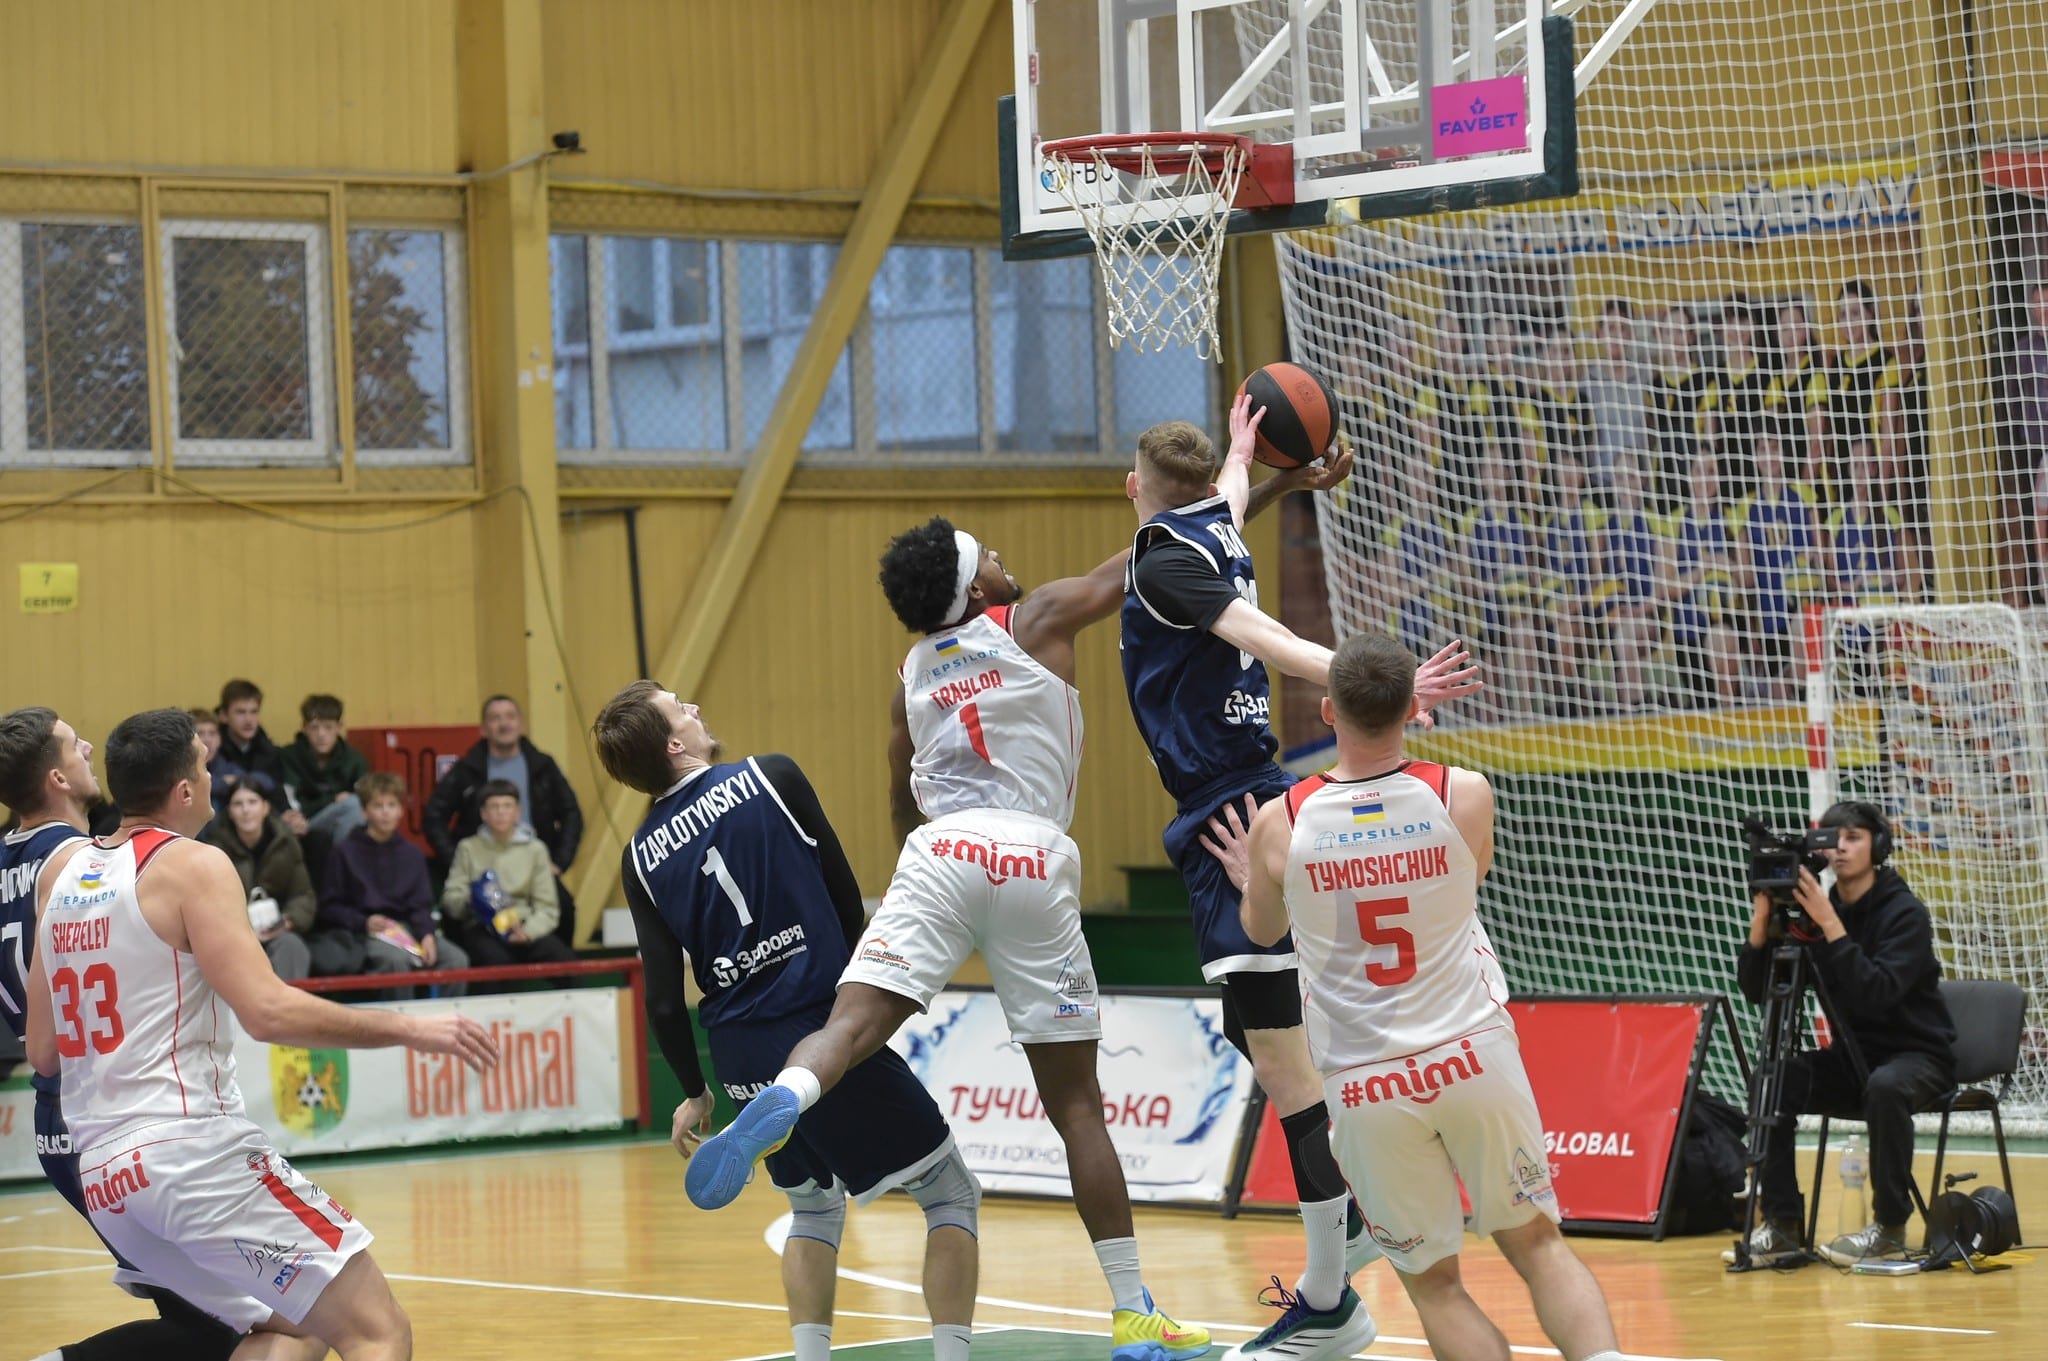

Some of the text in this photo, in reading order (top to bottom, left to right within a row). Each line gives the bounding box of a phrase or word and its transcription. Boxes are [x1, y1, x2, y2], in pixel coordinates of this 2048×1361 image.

[1439, 112, 1519, 137] FAVBET
[42, 570, 52, 586] 7
[931, 648, 999, 677] EPSILON
[929, 668, 1003, 711] TRAYLOR
[958, 702, 993, 767] 1
[638, 769, 760, 873] ZAPLOTYNSKYI
[1338, 821, 1432, 843] EPSILON
[700, 845, 754, 928] 1
[932, 838, 1048, 887] #mimi
[1305, 845, 1449, 893] TYMOSHCHUK
[63, 889, 118, 905] EPSILON
[52, 917, 111, 954] SHEPELEV
[1355, 896, 1418, 988] 5
[51, 962, 126, 1058] 33
[1341, 1039, 1484, 1109] #mimi
